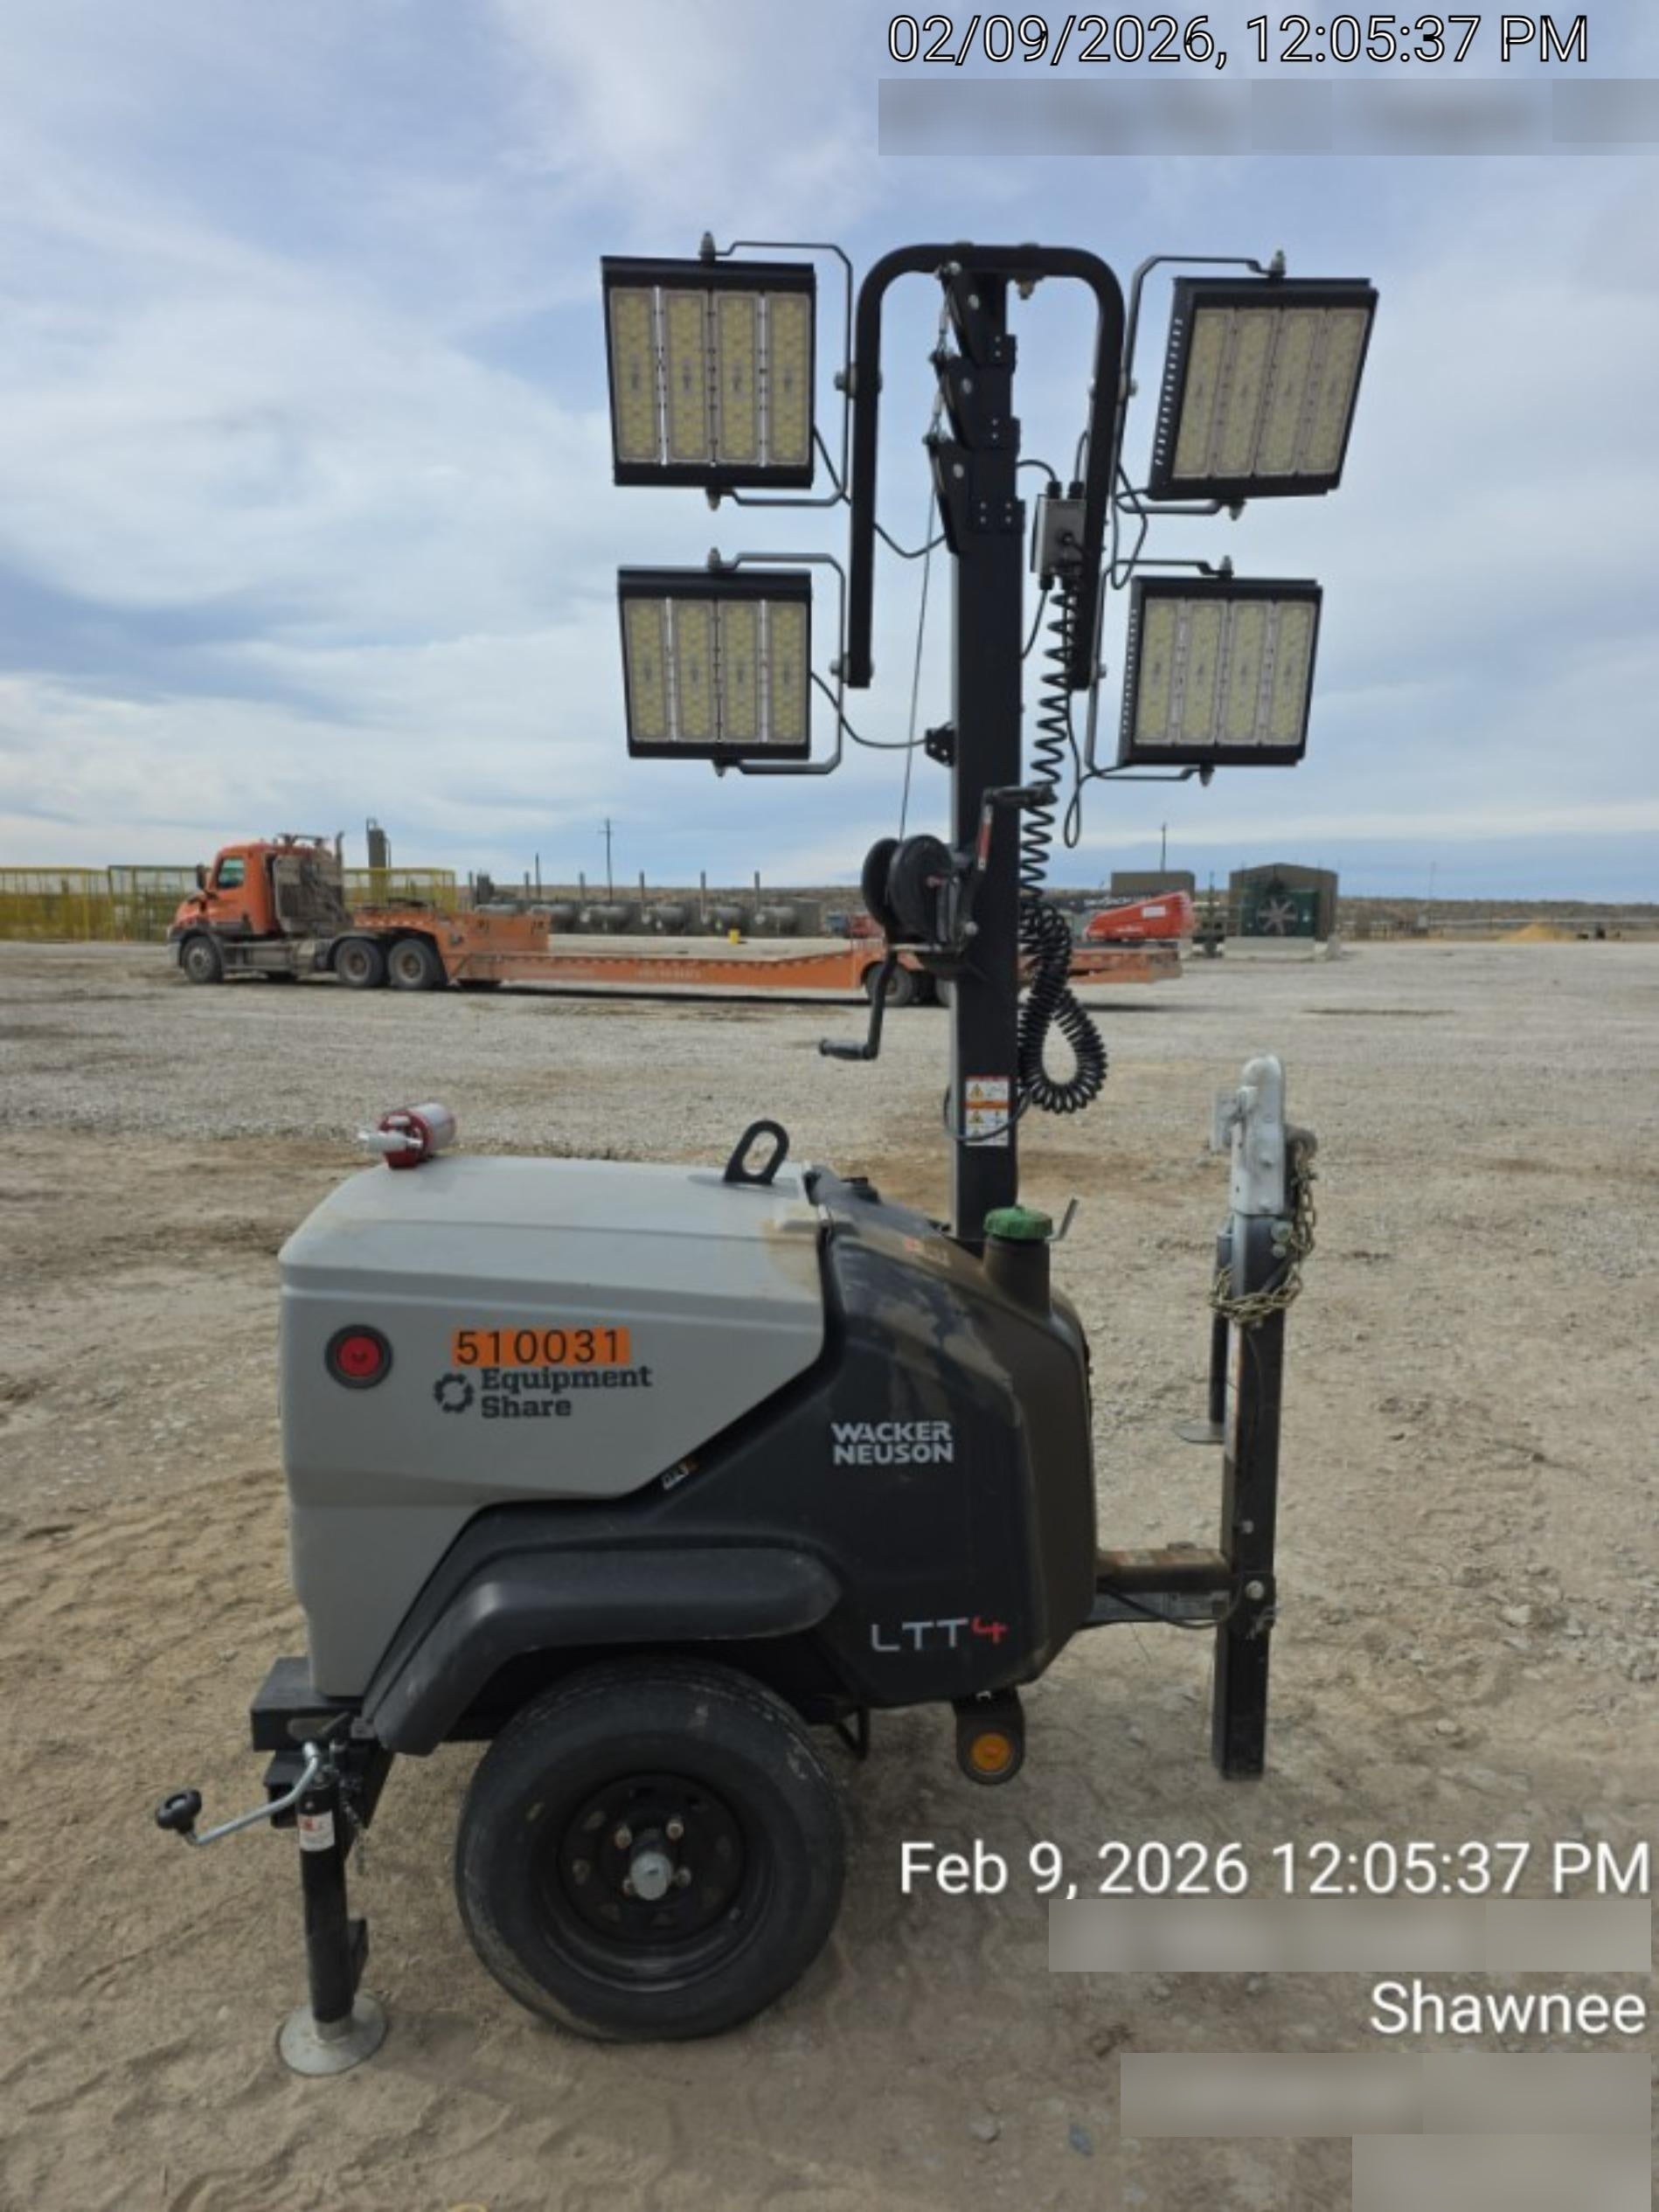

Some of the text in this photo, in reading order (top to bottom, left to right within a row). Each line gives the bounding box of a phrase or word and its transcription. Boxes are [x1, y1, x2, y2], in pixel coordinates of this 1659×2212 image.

[456, 1328, 619, 1365] 510031
[481, 1366, 652, 1394] Equipment
[481, 1395, 573, 1419] Share
[831, 1421, 952, 1442] WACKER
[833, 1443, 954, 1465] NEUSON
